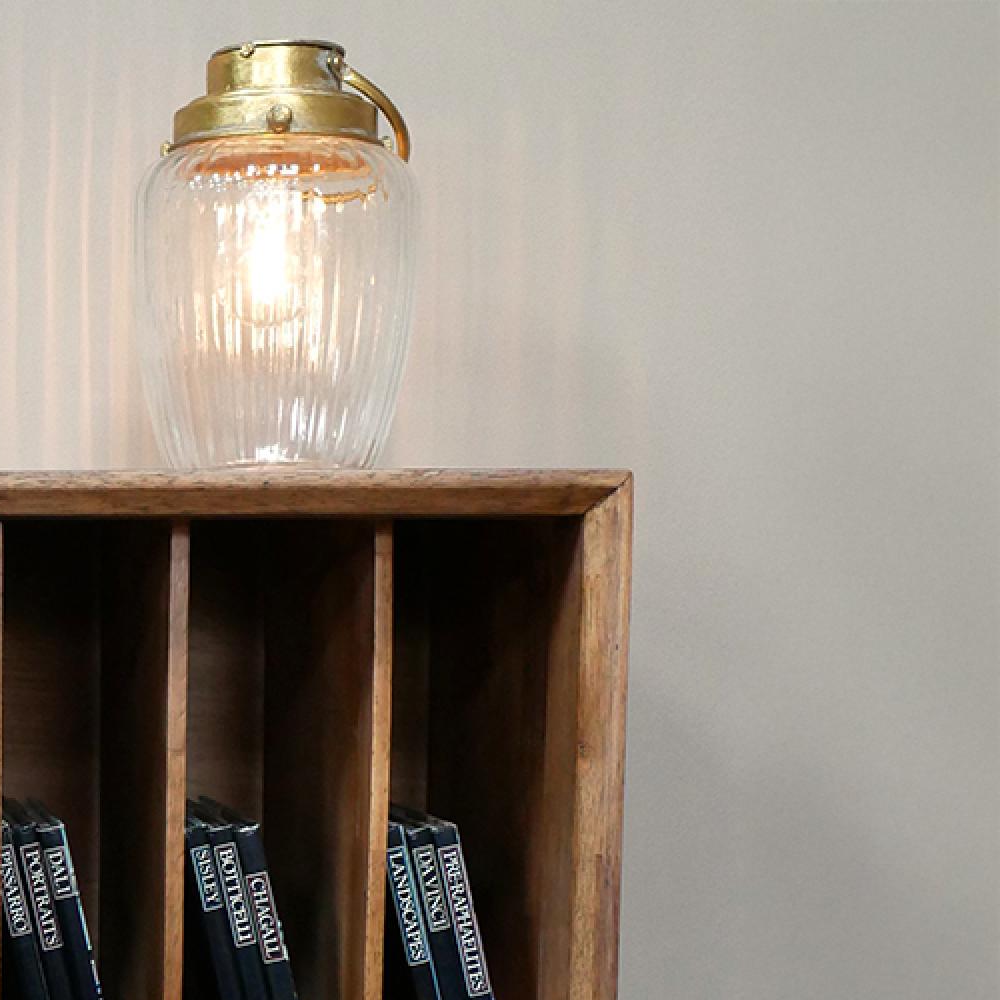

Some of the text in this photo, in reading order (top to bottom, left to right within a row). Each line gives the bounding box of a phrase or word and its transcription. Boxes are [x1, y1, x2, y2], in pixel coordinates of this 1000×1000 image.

[25, 850, 58, 945] PORTRAITS
[195, 849, 219, 903] SISLEY
[219, 849, 252, 941] BOTTICELLI
[250, 877, 283, 958] CHAGALL
[389, 852, 425, 961] LANDSCAPES
